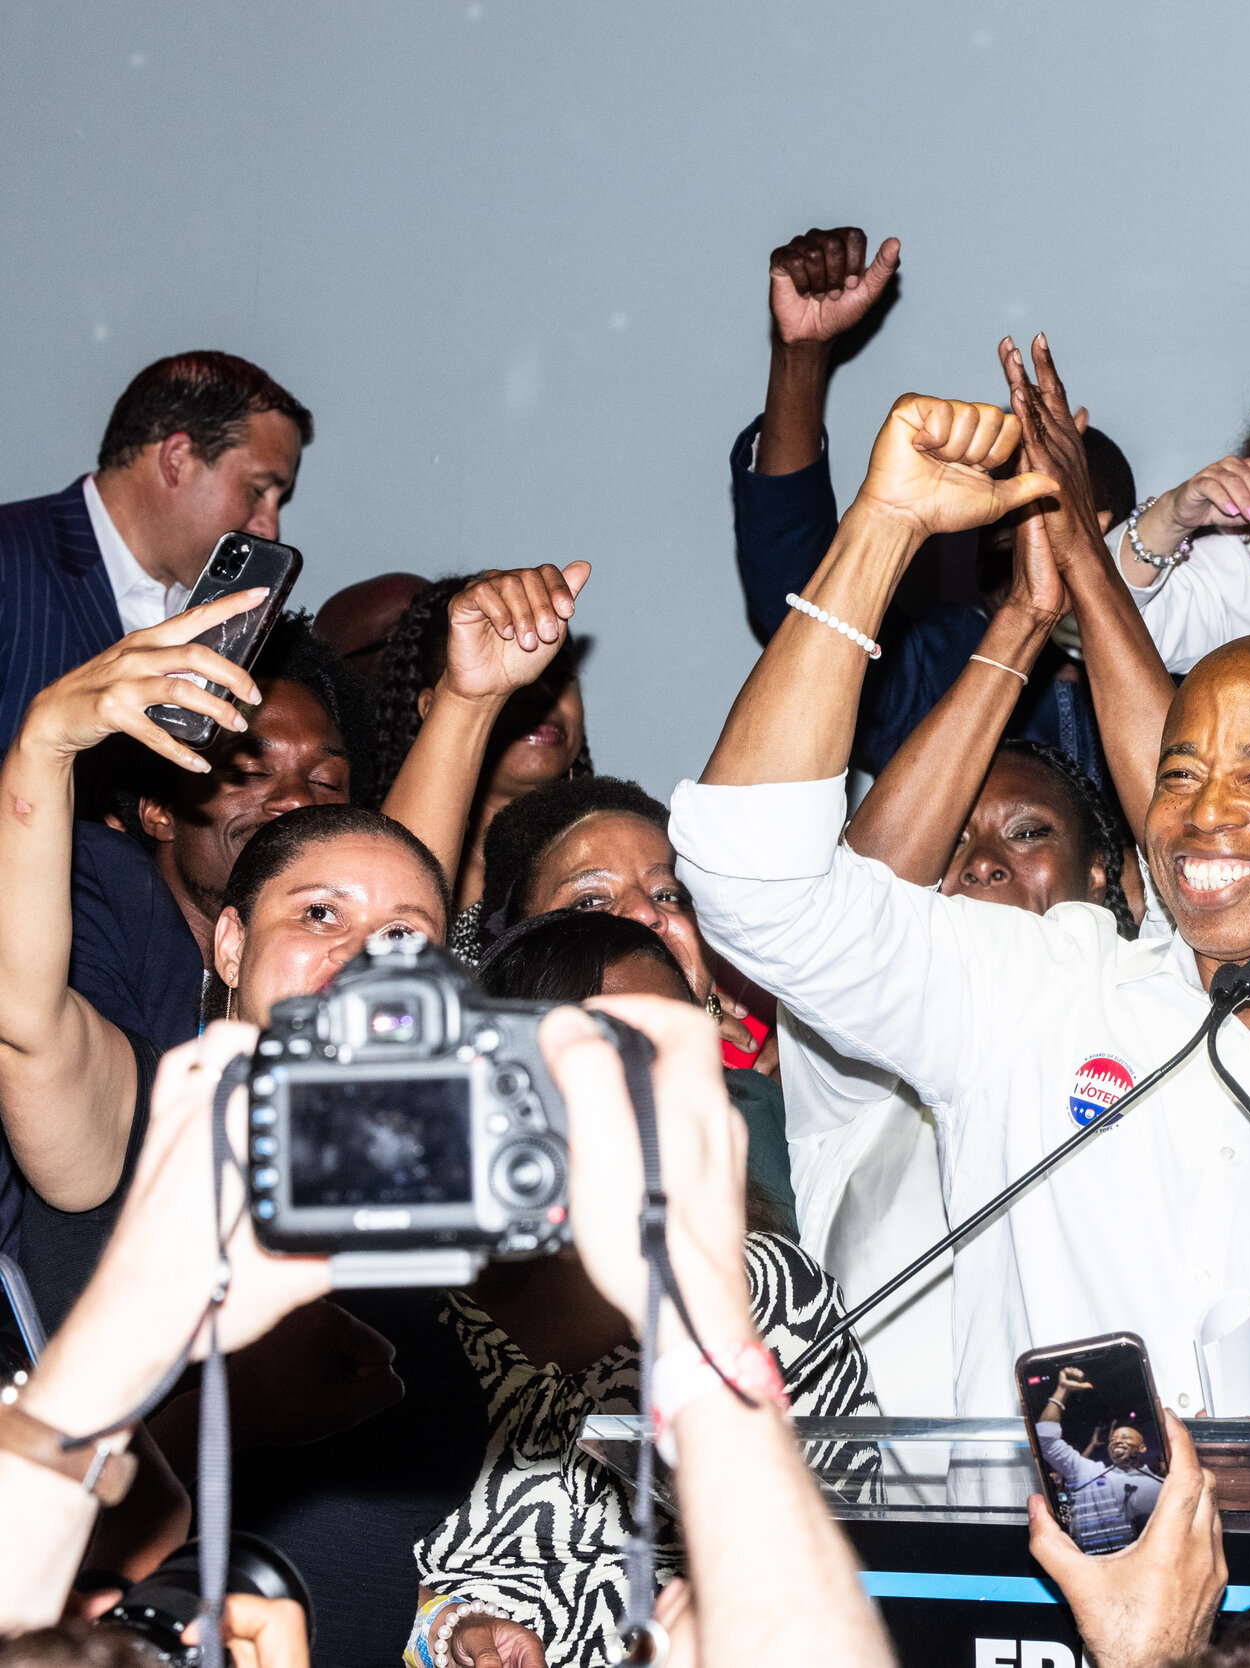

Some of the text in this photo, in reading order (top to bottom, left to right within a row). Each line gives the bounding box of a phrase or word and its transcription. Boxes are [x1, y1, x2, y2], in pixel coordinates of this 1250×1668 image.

[1114, 1056, 1134, 1075] ELECTIONS
[1074, 1081, 1121, 1106] I VOTED
